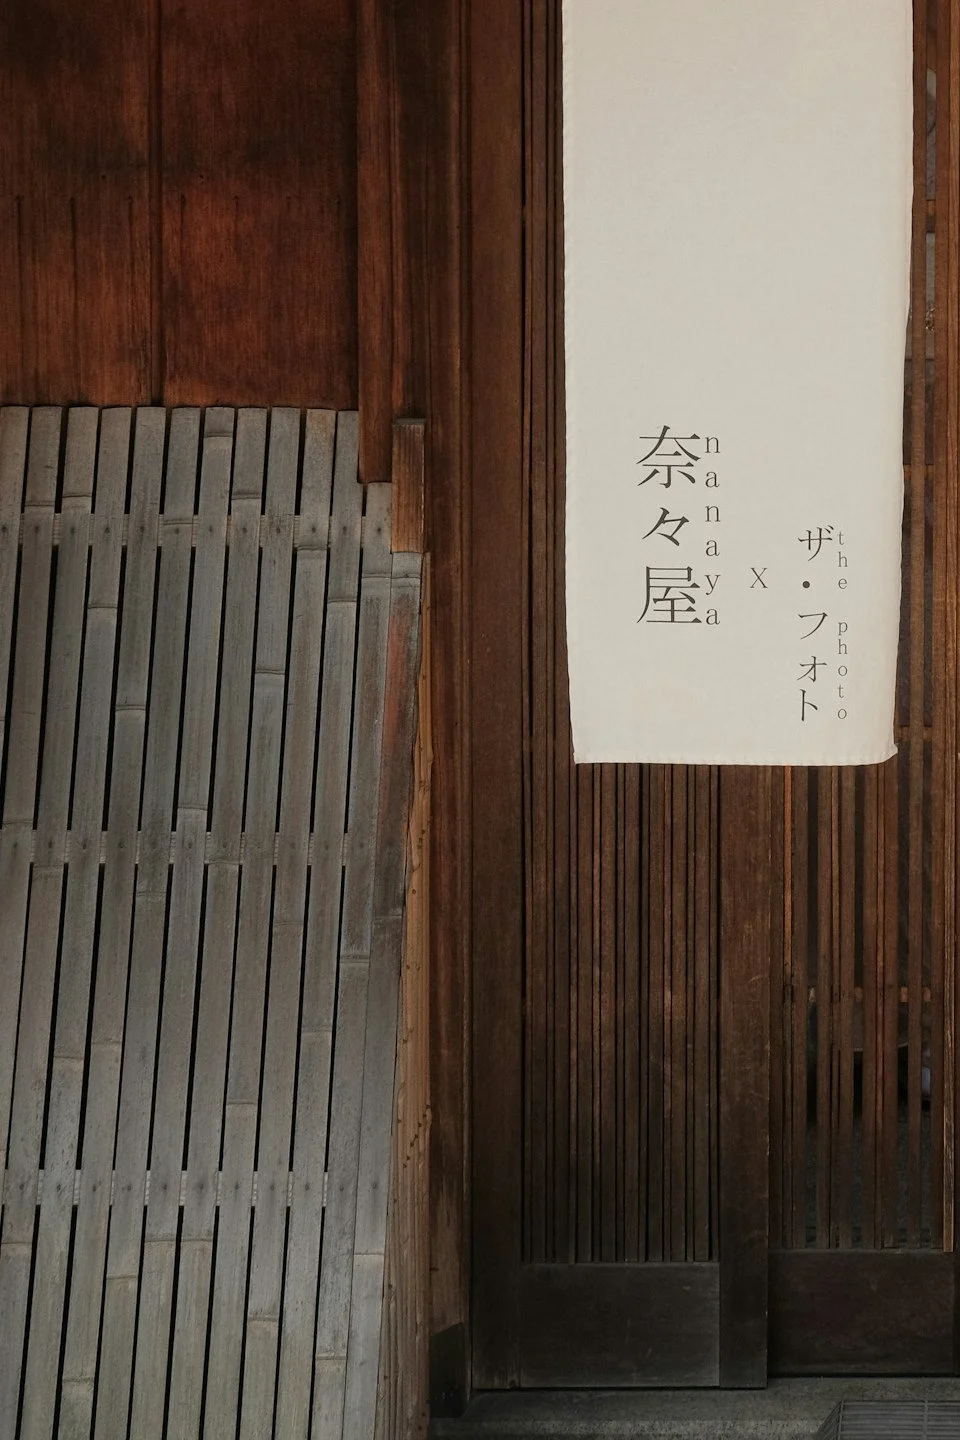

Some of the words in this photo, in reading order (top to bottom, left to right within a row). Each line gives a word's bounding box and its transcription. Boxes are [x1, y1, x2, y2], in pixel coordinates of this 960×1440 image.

[636, 424, 703, 624] 奈々屋
[704, 435, 721, 626] nanaya
[837, 531, 849, 591] the
[837, 620, 849, 720] photo
